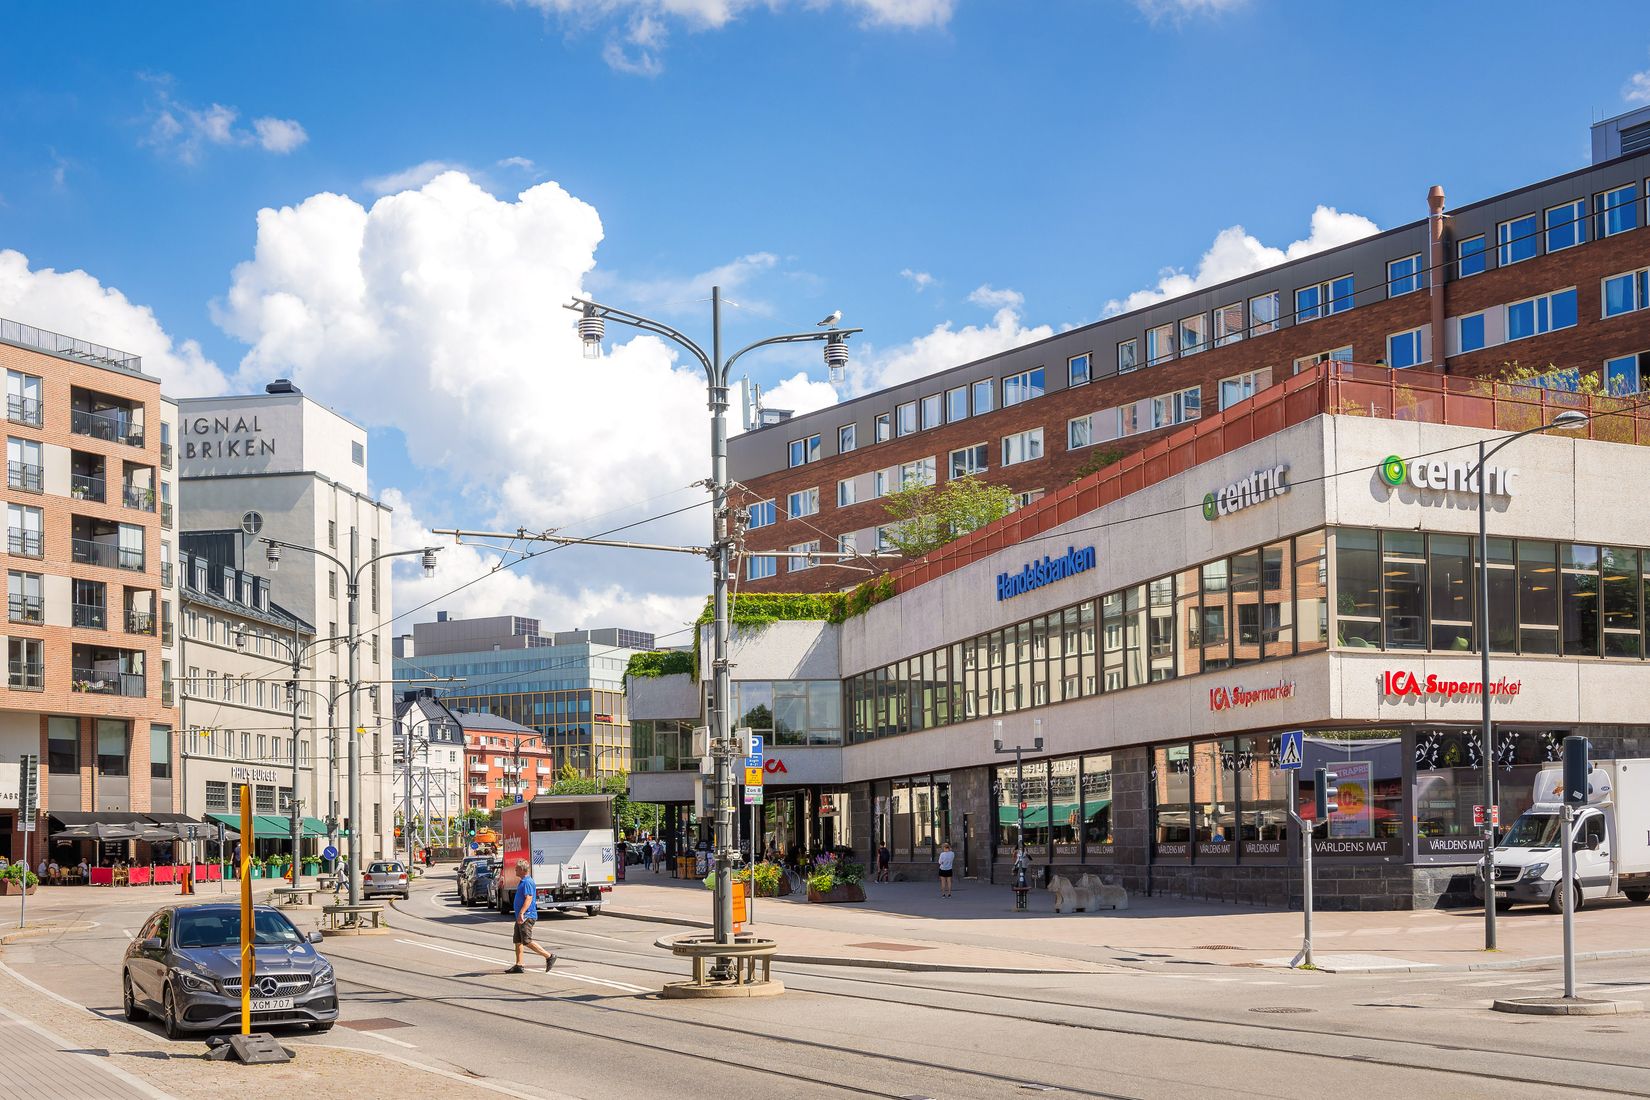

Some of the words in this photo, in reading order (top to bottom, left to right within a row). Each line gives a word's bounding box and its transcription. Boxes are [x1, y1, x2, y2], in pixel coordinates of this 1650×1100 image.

[184, 415, 262, 435] IGNAL
[178, 438, 275, 460] BRIKEN
[1411, 459, 1520, 497] centric
[1217, 464, 1287, 517] centric
[997, 545, 1096, 602] Handelsbanken
[1209, 686, 1231, 711] ICA
[1231, 679, 1294, 708] Supermarket
[1384, 670, 1423, 696] ICA
[1425, 674, 1522, 698] Supermarket
[1246, 842, 1269, 853] VÄRLDENS
[1269, 843, 1280, 852] MAT
[1315, 841, 1365, 852] VÄRLDENS
[1366, 841, 1388, 852] MAT
[1429, 839, 1468, 850] VÄRLDENS
[1468, 839, 1485, 850] MAT
[252, 1001, 271, 1010] XGM
[272, 999, 290, 1009] 707
